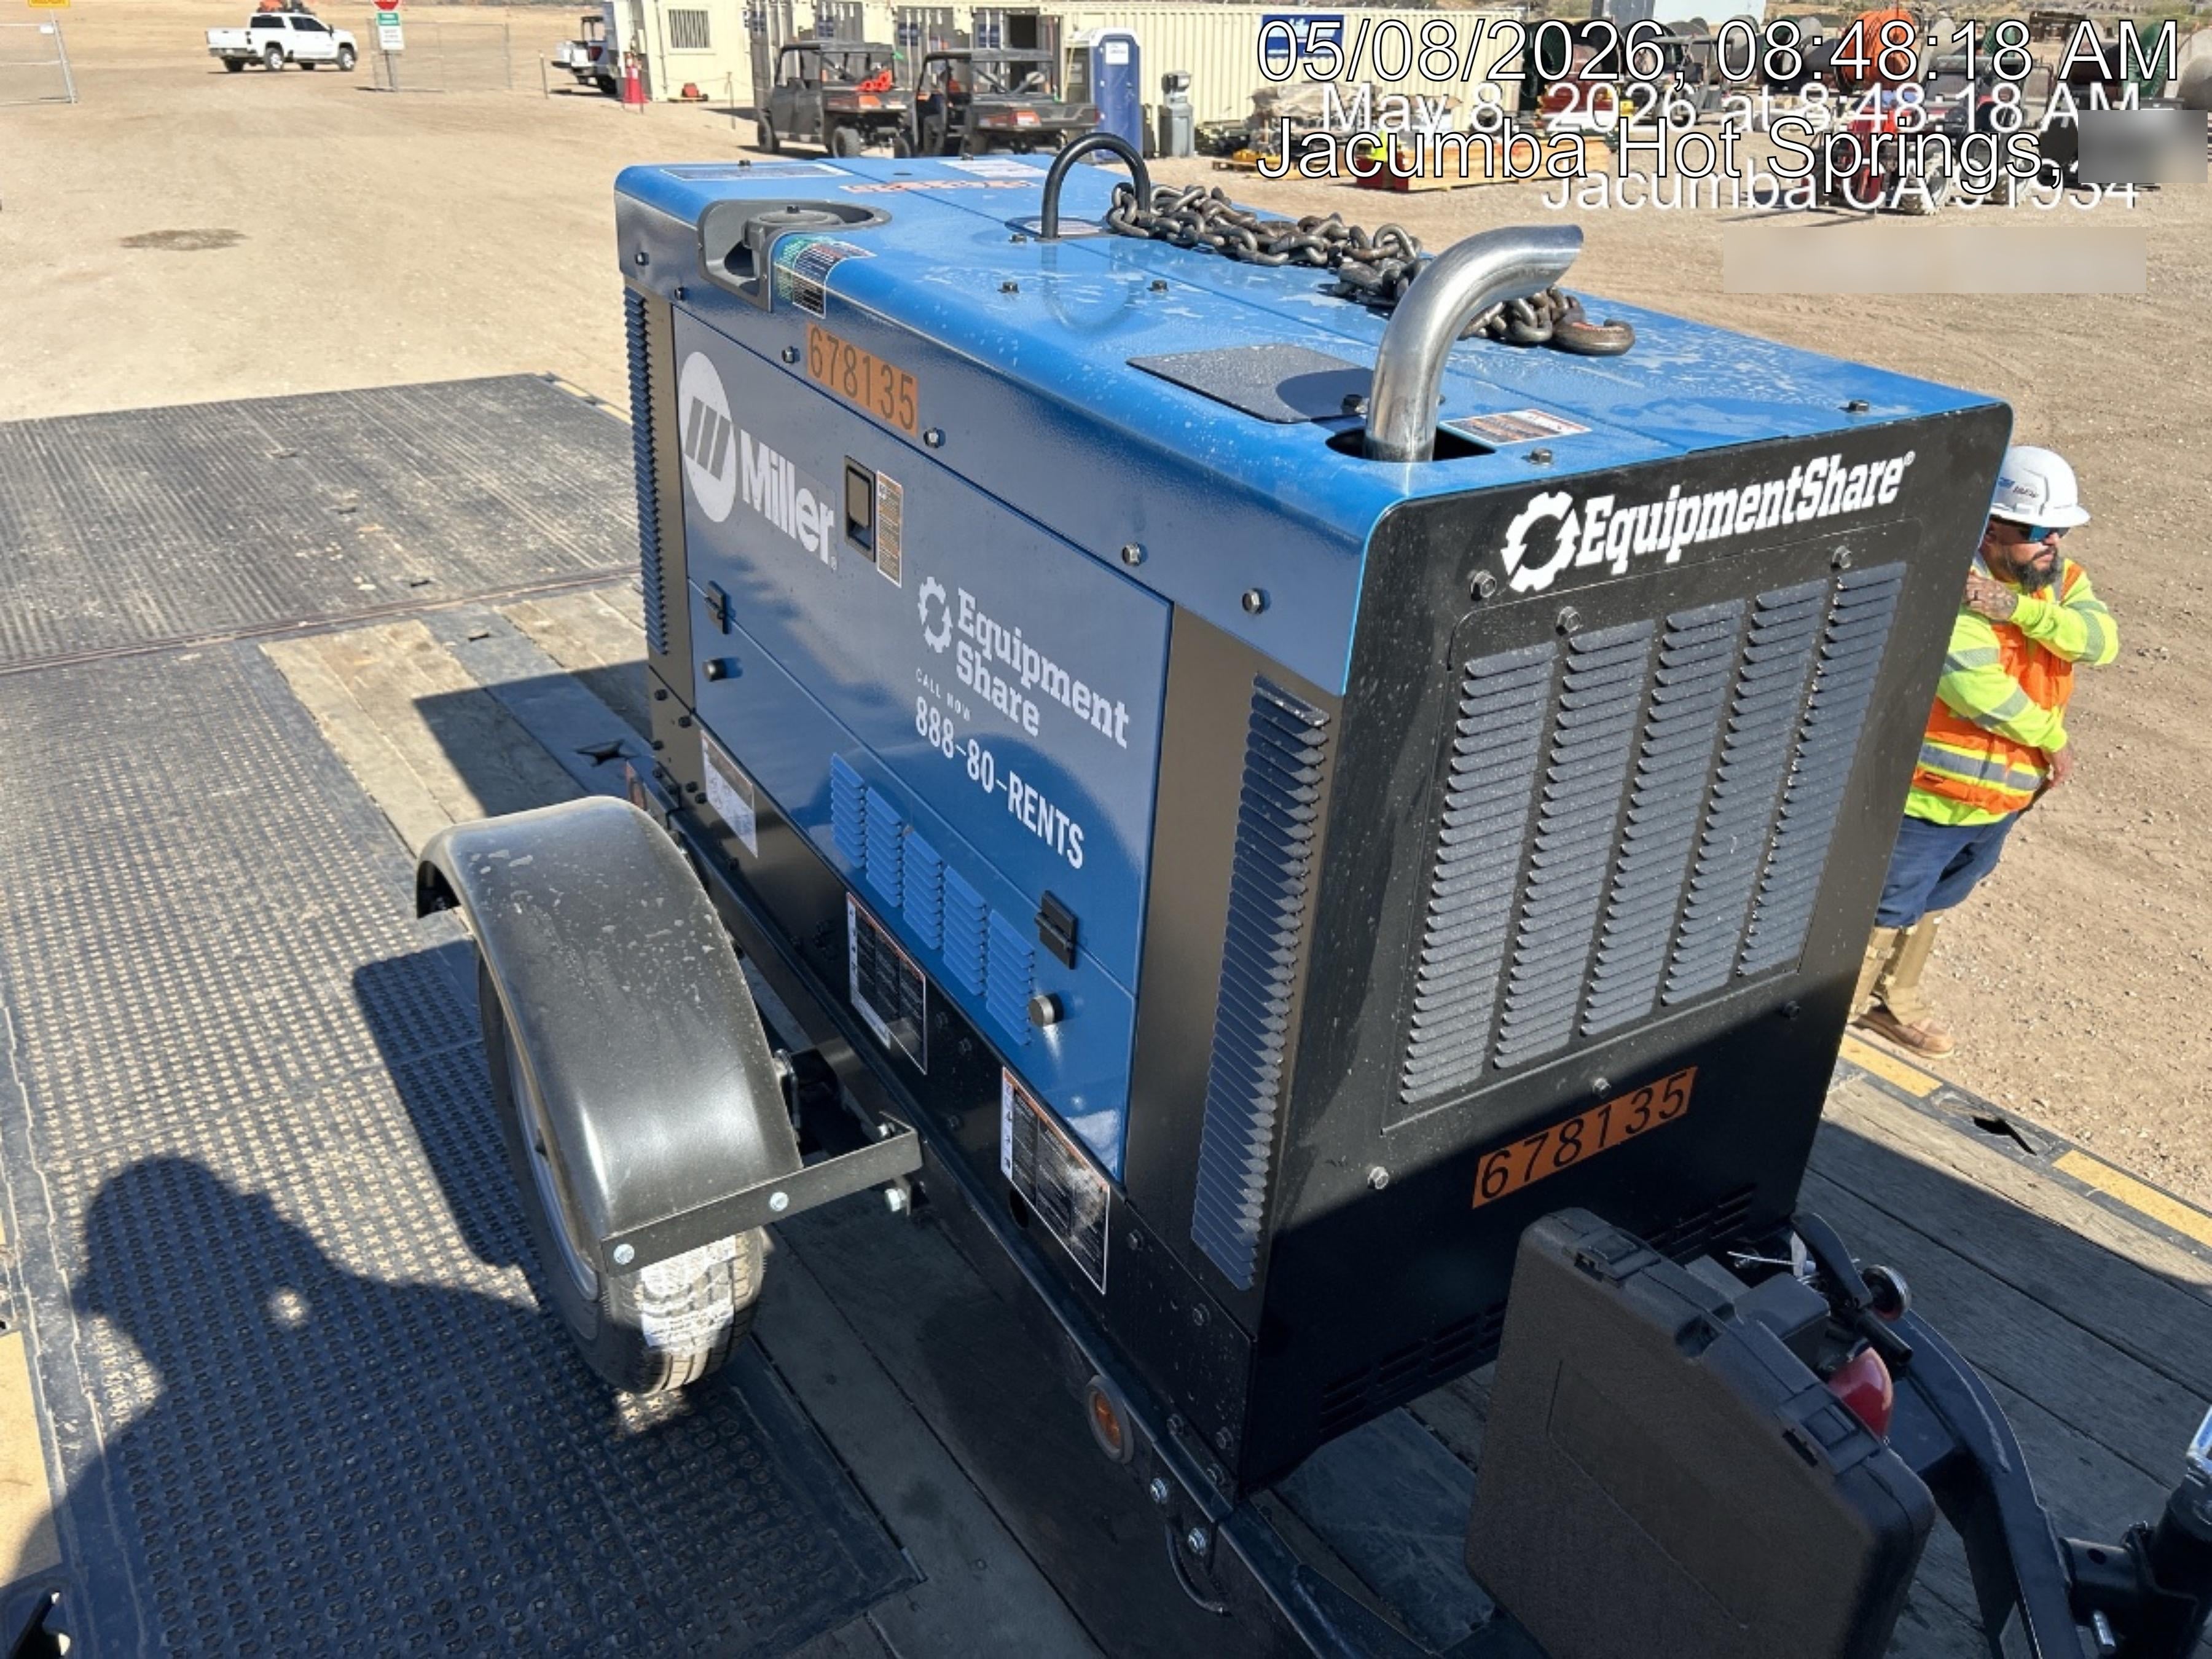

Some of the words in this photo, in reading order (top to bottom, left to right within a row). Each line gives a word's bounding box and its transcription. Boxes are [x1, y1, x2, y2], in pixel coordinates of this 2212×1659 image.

[809, 326, 915, 431] 678135
[740, 429, 834, 565] Miller
[1576, 453, 1905, 575] EquipmentShare
[916, 667, 941, 699] CALL
[947, 692, 971, 722] NOW
[956, 640, 1040, 737] Share
[957, 587, 1130, 749] Equipment
[915, 696, 1084, 869] 888-80-RENTS
[1481, 1071, 1688, 1199] 678135
